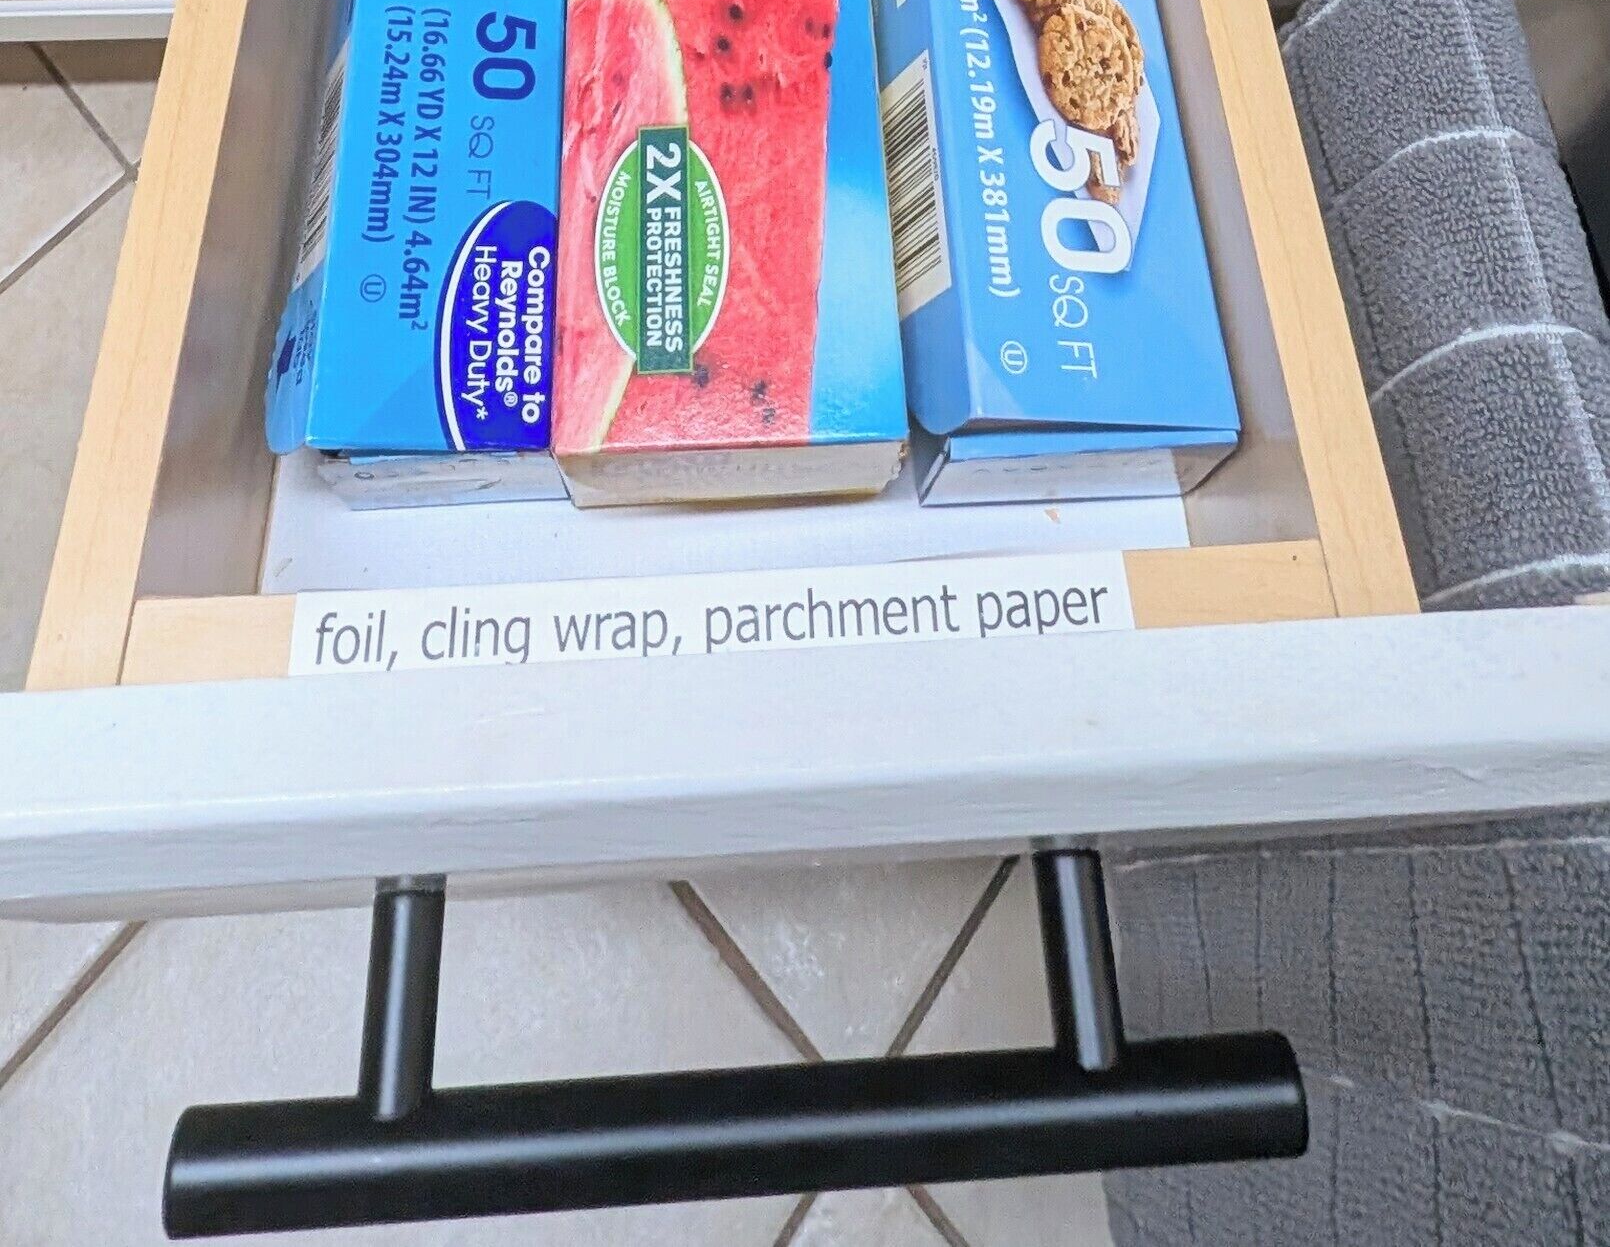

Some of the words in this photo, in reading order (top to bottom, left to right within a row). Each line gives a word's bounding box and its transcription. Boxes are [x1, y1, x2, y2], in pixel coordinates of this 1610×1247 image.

[379, 6, 416, 105] (15.24m
[419, 8, 451, 83] (16.66
[473, 11, 537, 101] 50
[377, 110, 406, 127] X
[416, 88, 445, 120] YD
[959, 26, 997, 147] (12.19m
[410, 148, 439, 178] 12
[414, 125, 442, 142] X
[468, 115, 495, 159] SQ
[976, 147, 1004, 164] X
[361, 132, 403, 243] 304mm)
[402, 185, 437, 224] IN)
[466, 169, 492, 199] FT
[602, 171, 632, 262] MOISTURE
[694, 180, 721, 260] AIRTIGHT
[1029, 119, 1132, 274] 50
[646, 142, 682, 204] 2X
[664, 206, 683, 353] FRESHNESS
[980, 169, 1021, 298] 381mm)
[466, 245, 497, 334] Heavy
[602, 267, 632, 327] BLOCK
[646, 207, 663, 347] PROTECTION
[697, 263, 720, 307] SEAL
[1049, 273, 1089, 329] SQ
[521, 246, 550, 385] Compare
[1057, 339, 1098, 379] FT
[521, 391, 546, 424] to
[315, 609, 398, 672] foil,
[421, 606, 532, 665] cling
[553, 608, 683, 657] wrap,
[705, 584, 961, 654] parchment
[976, 585, 1108, 639] paper
